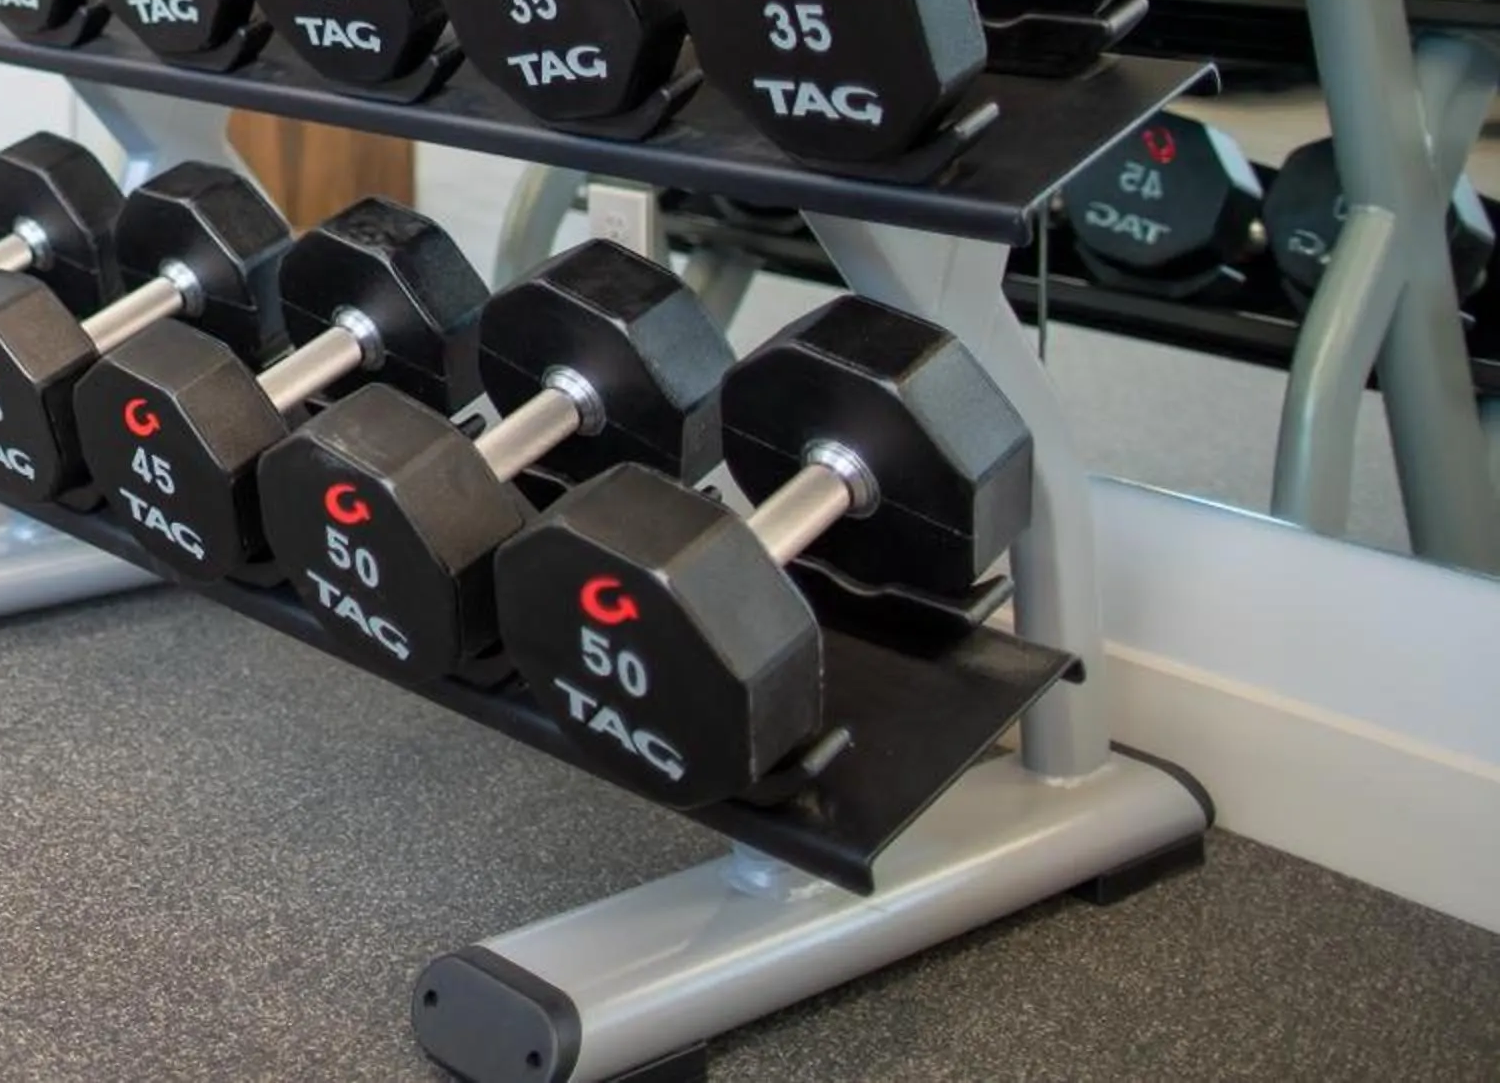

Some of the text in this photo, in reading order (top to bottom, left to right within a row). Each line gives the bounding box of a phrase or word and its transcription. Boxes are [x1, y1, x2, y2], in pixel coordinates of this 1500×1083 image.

[294, 16, 381, 53] TAG
[763, 2, 832, 52] 35
[507, 45, 608, 86] TAG
[753, 78, 884, 126] TAG
[130, 447, 175, 496] 45
[119, 486, 206, 562] TAG
[325, 525, 380, 589] 50
[305, 568, 411, 662] TAG
[579, 627, 648, 699] 50
[553, 677, 686, 783] TAG
